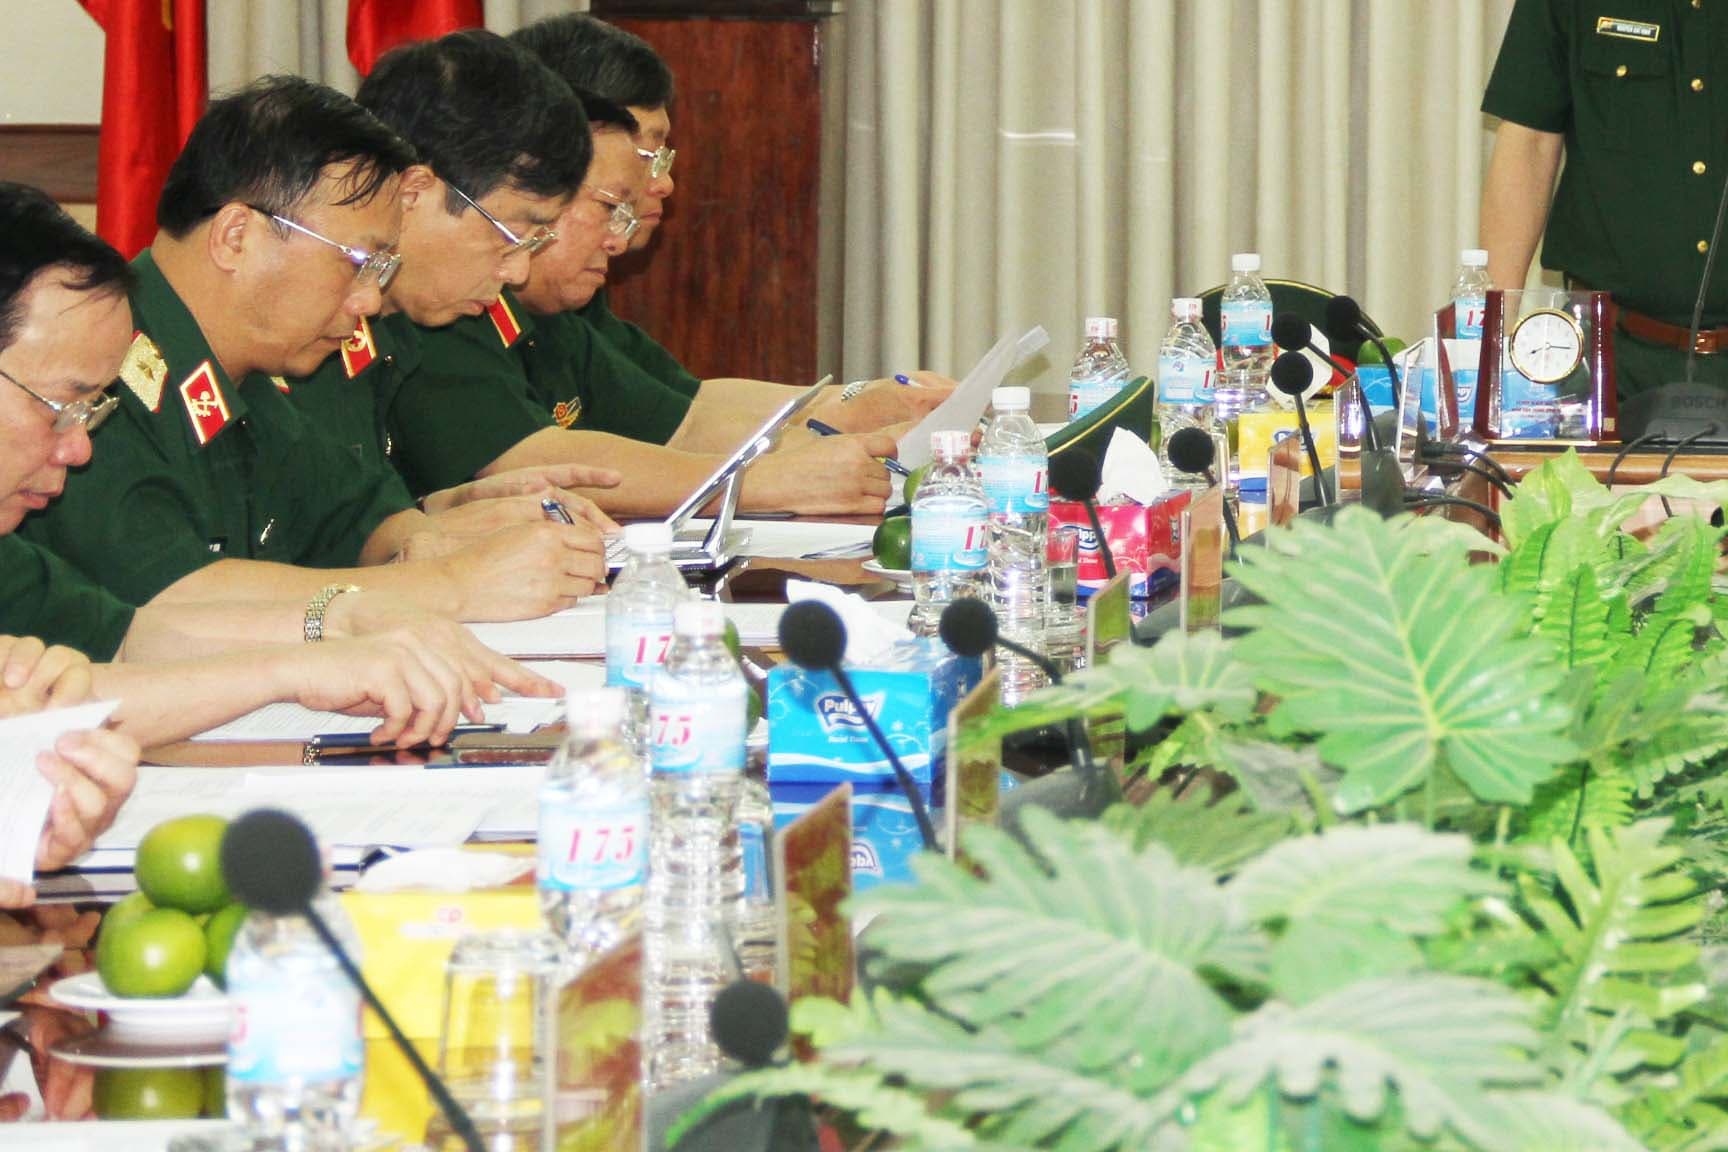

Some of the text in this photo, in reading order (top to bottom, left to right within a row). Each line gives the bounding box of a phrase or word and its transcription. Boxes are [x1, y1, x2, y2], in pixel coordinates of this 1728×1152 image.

[634, 635, 672, 664] 17
[654, 714, 692, 746] 75
[567, 826, 635, 863] 175
